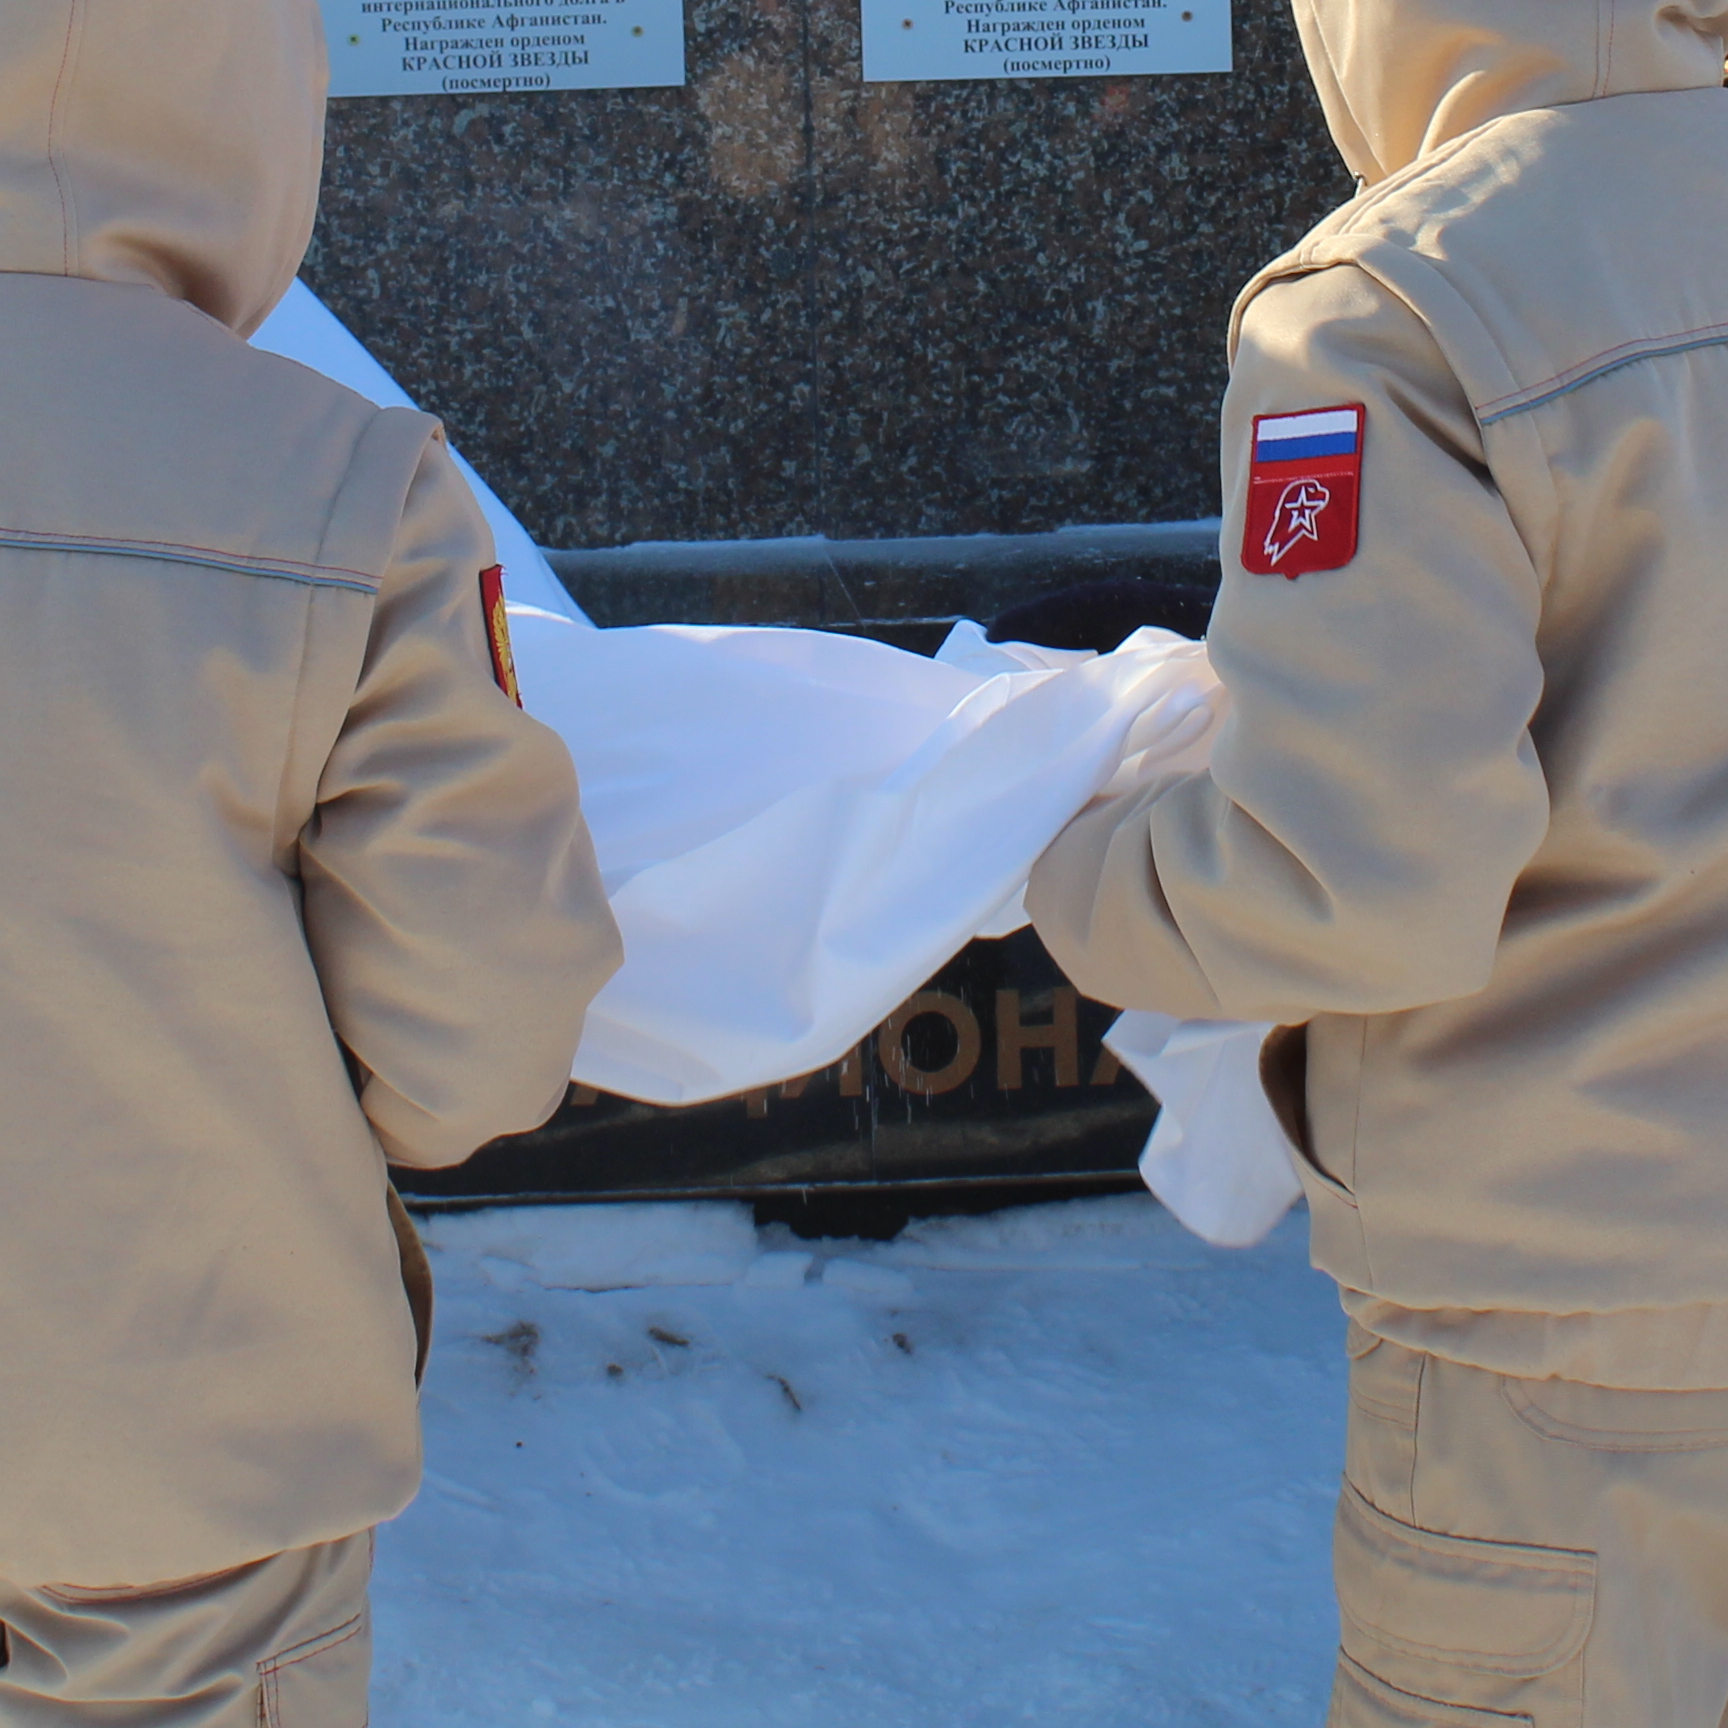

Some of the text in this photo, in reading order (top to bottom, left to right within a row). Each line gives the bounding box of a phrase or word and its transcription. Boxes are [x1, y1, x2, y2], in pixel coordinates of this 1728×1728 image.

[381, 12, 607, 35] Республике Афганистан.
[967, 16, 1145, 36] Награжден орденом
[404, 33, 585, 55] Награжден орденом
[964, 32, 1149, 54] КРАСНОЙ ЗВЕЗДЫ
[401, 49, 589, 72] КРАСНОЙ ЗВЕЗДЫ
[1003, 55, 1111, 74] (посмертно)
[442, 73, 551, 93] (посмертно)
